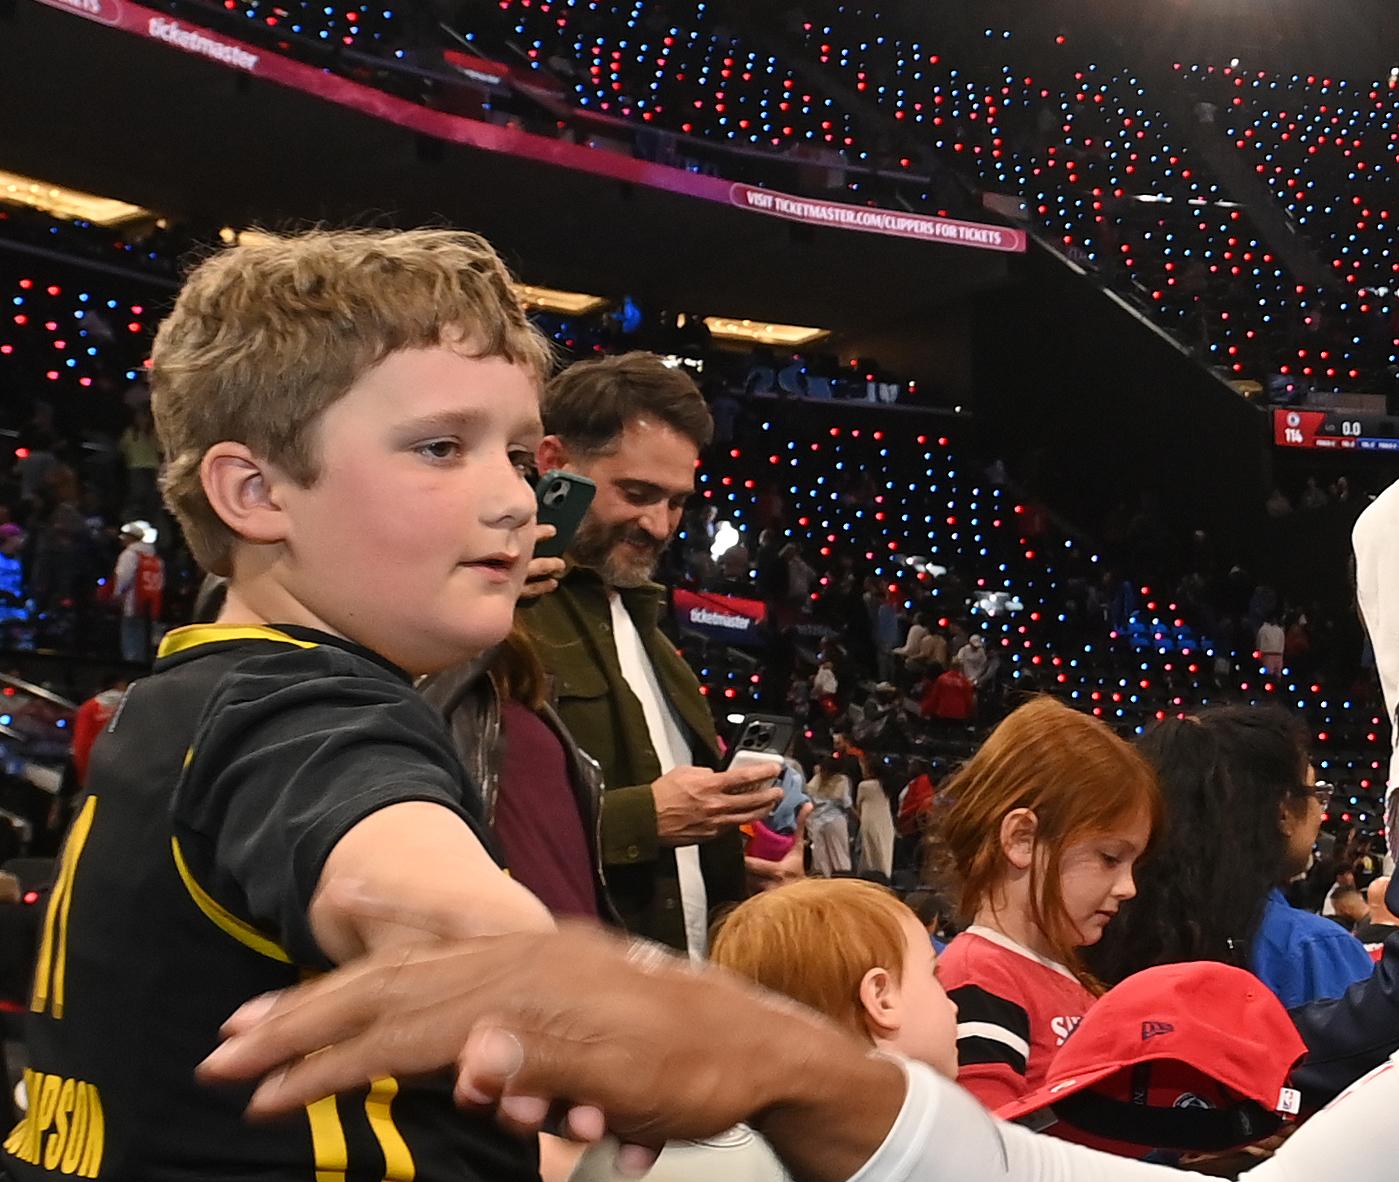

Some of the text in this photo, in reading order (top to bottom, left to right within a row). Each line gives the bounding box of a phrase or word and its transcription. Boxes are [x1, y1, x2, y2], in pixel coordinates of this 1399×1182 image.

[149, 17, 259, 69] ticketmaster
[746, 191, 1001, 246] VISIT TICKETMASTER.COM/CLIPPERS FOR TICKETS
[1342, 421, 1361, 436] 0.0
[690, 608, 750, 629] ticketmaster
